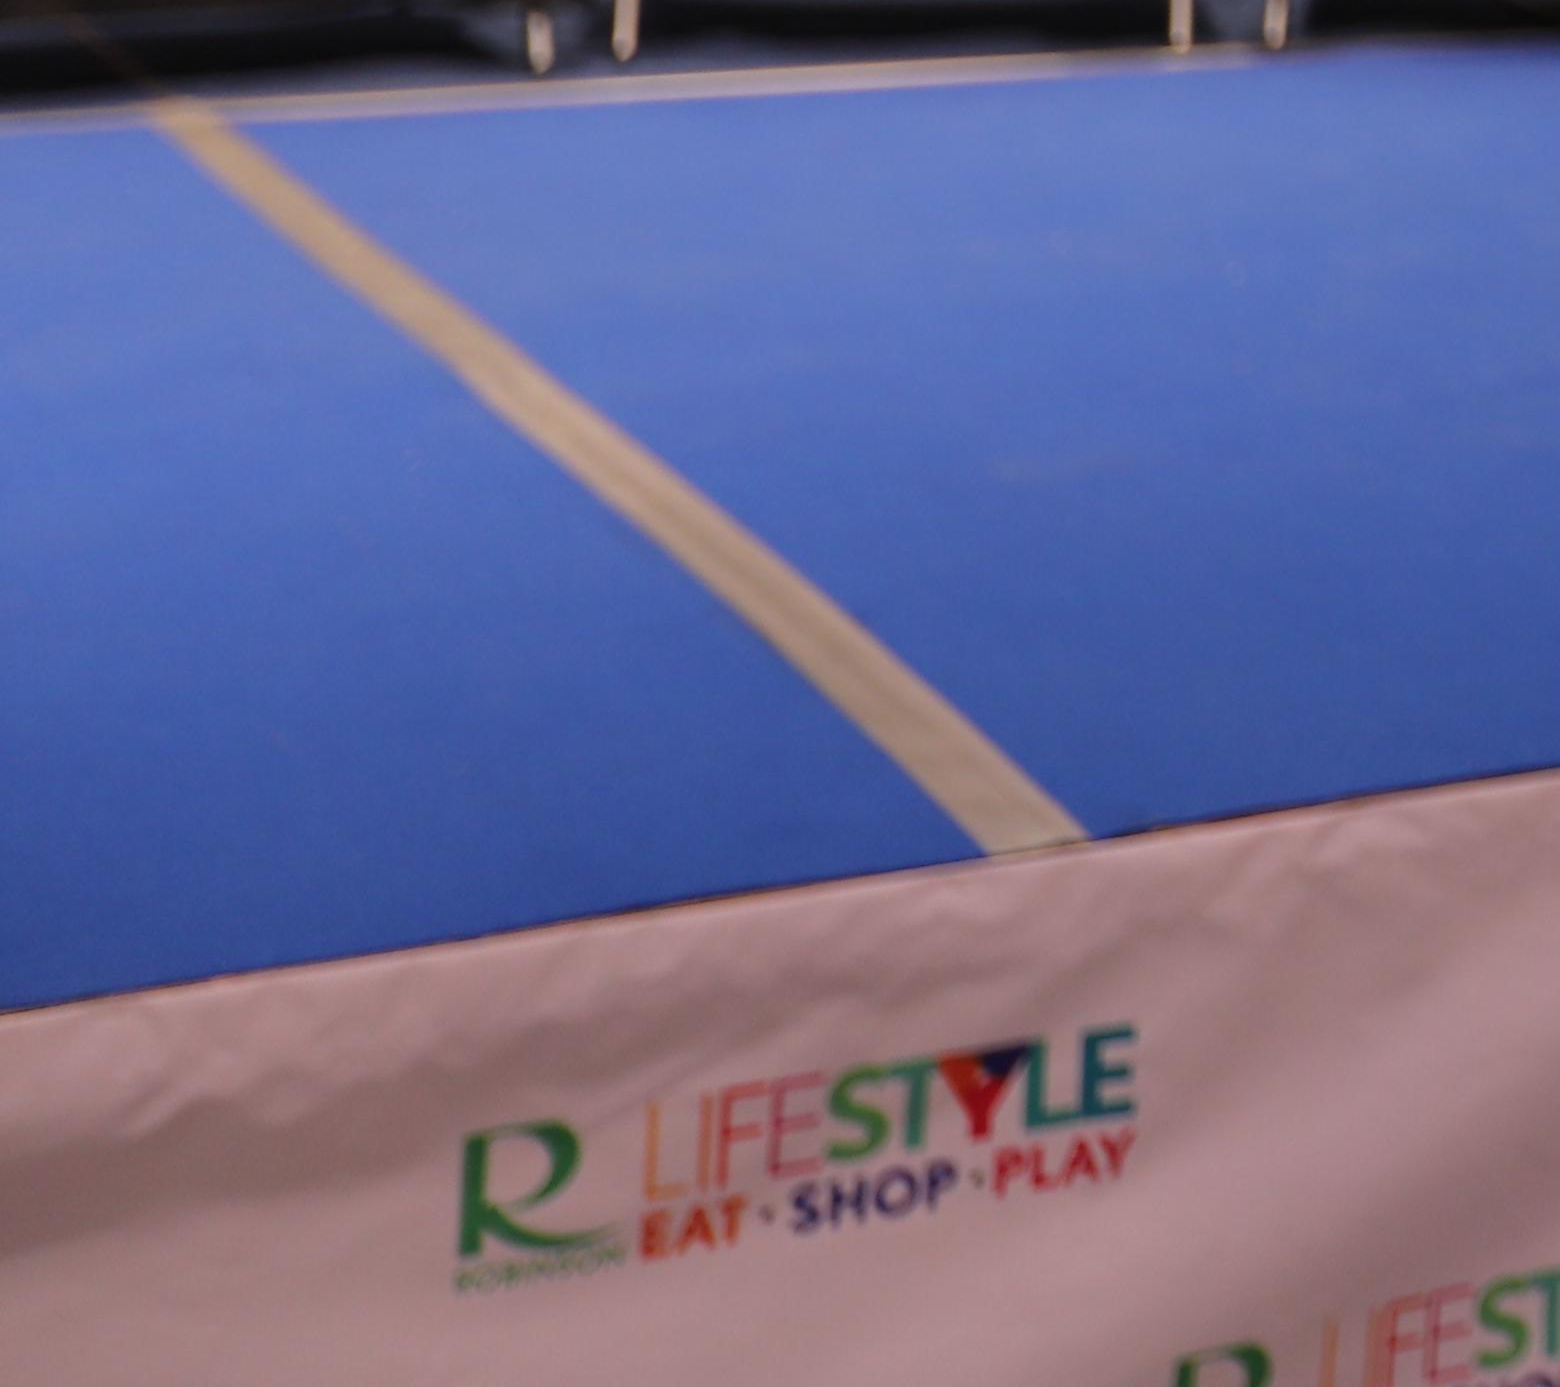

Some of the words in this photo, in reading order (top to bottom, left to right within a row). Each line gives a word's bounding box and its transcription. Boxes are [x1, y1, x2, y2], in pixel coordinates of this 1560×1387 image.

[458, 1119, 620, 1259] R
[641, 1024, 1140, 1202] LIFESTYLE
[638, 1194, 750, 1263] EAT
[788, 1158, 958, 1235] SHOP
[991, 1129, 1138, 1198] PLAY
